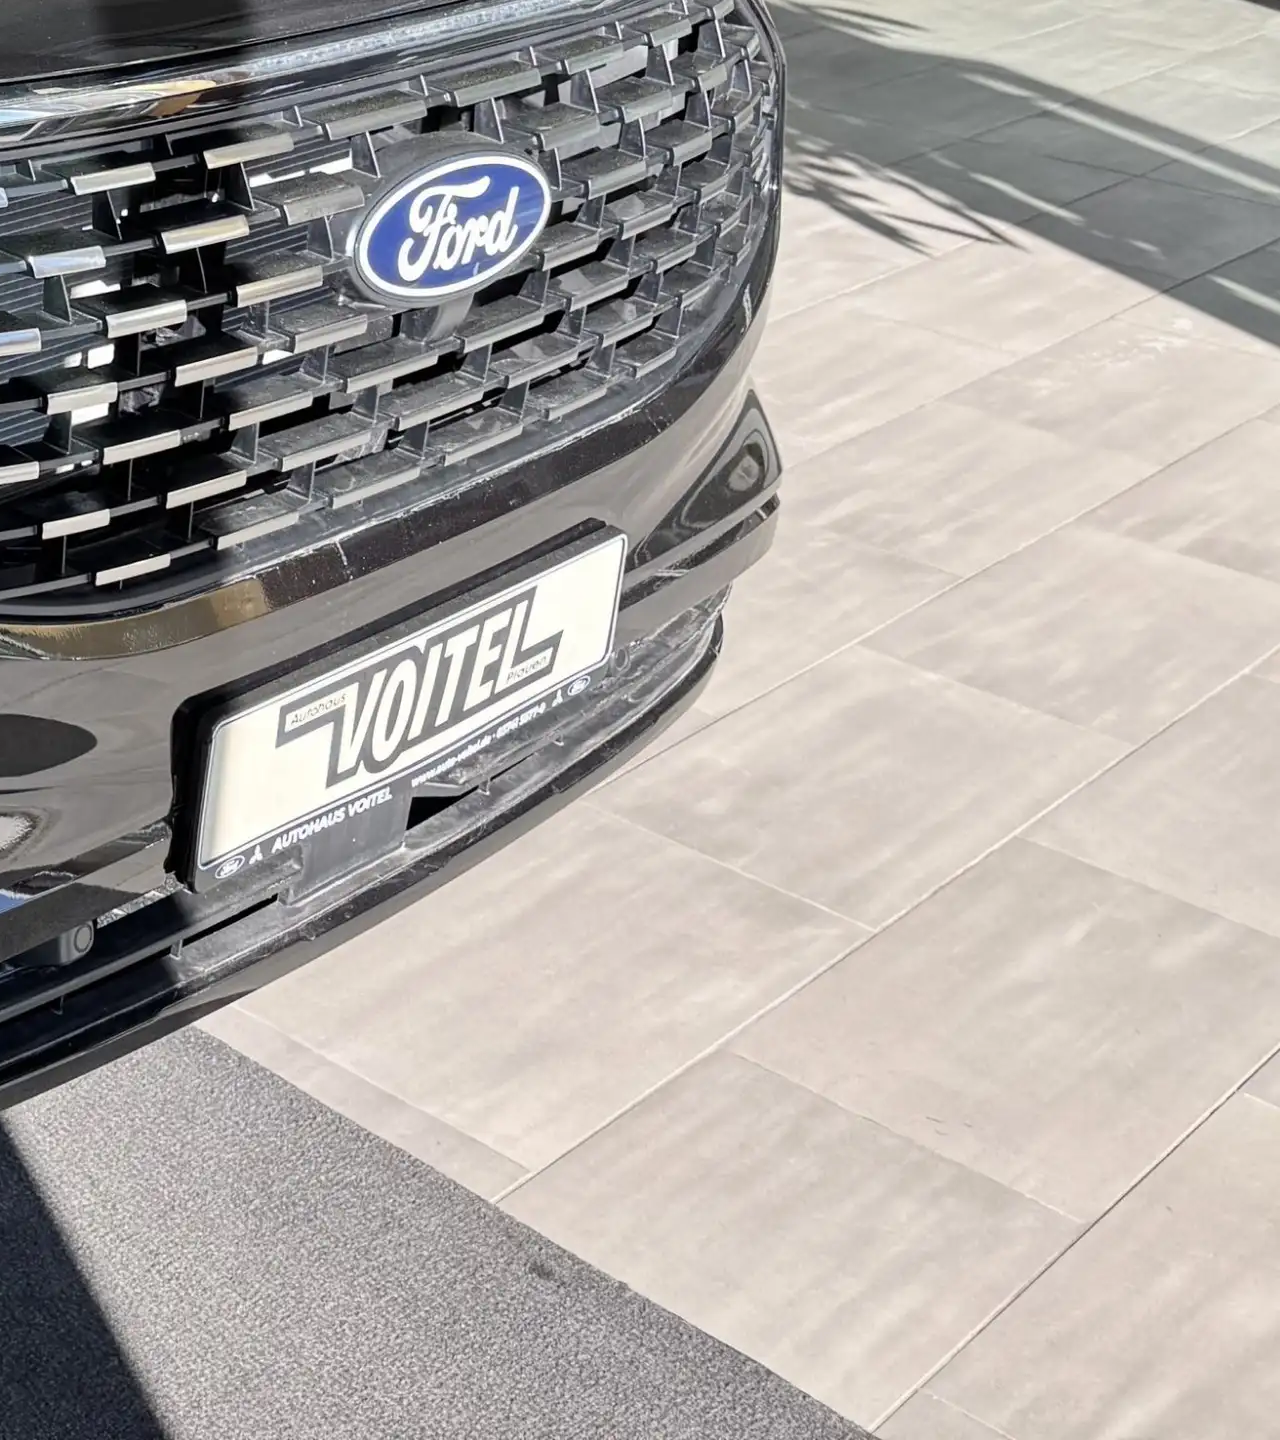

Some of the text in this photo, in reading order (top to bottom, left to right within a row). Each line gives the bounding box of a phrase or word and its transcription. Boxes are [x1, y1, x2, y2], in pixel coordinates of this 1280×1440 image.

[397, 175, 520, 282] Ford
[330, 595, 548, 780] VOITEL
[270, 786, 395, 854] AUTOHAUS VOITEL
